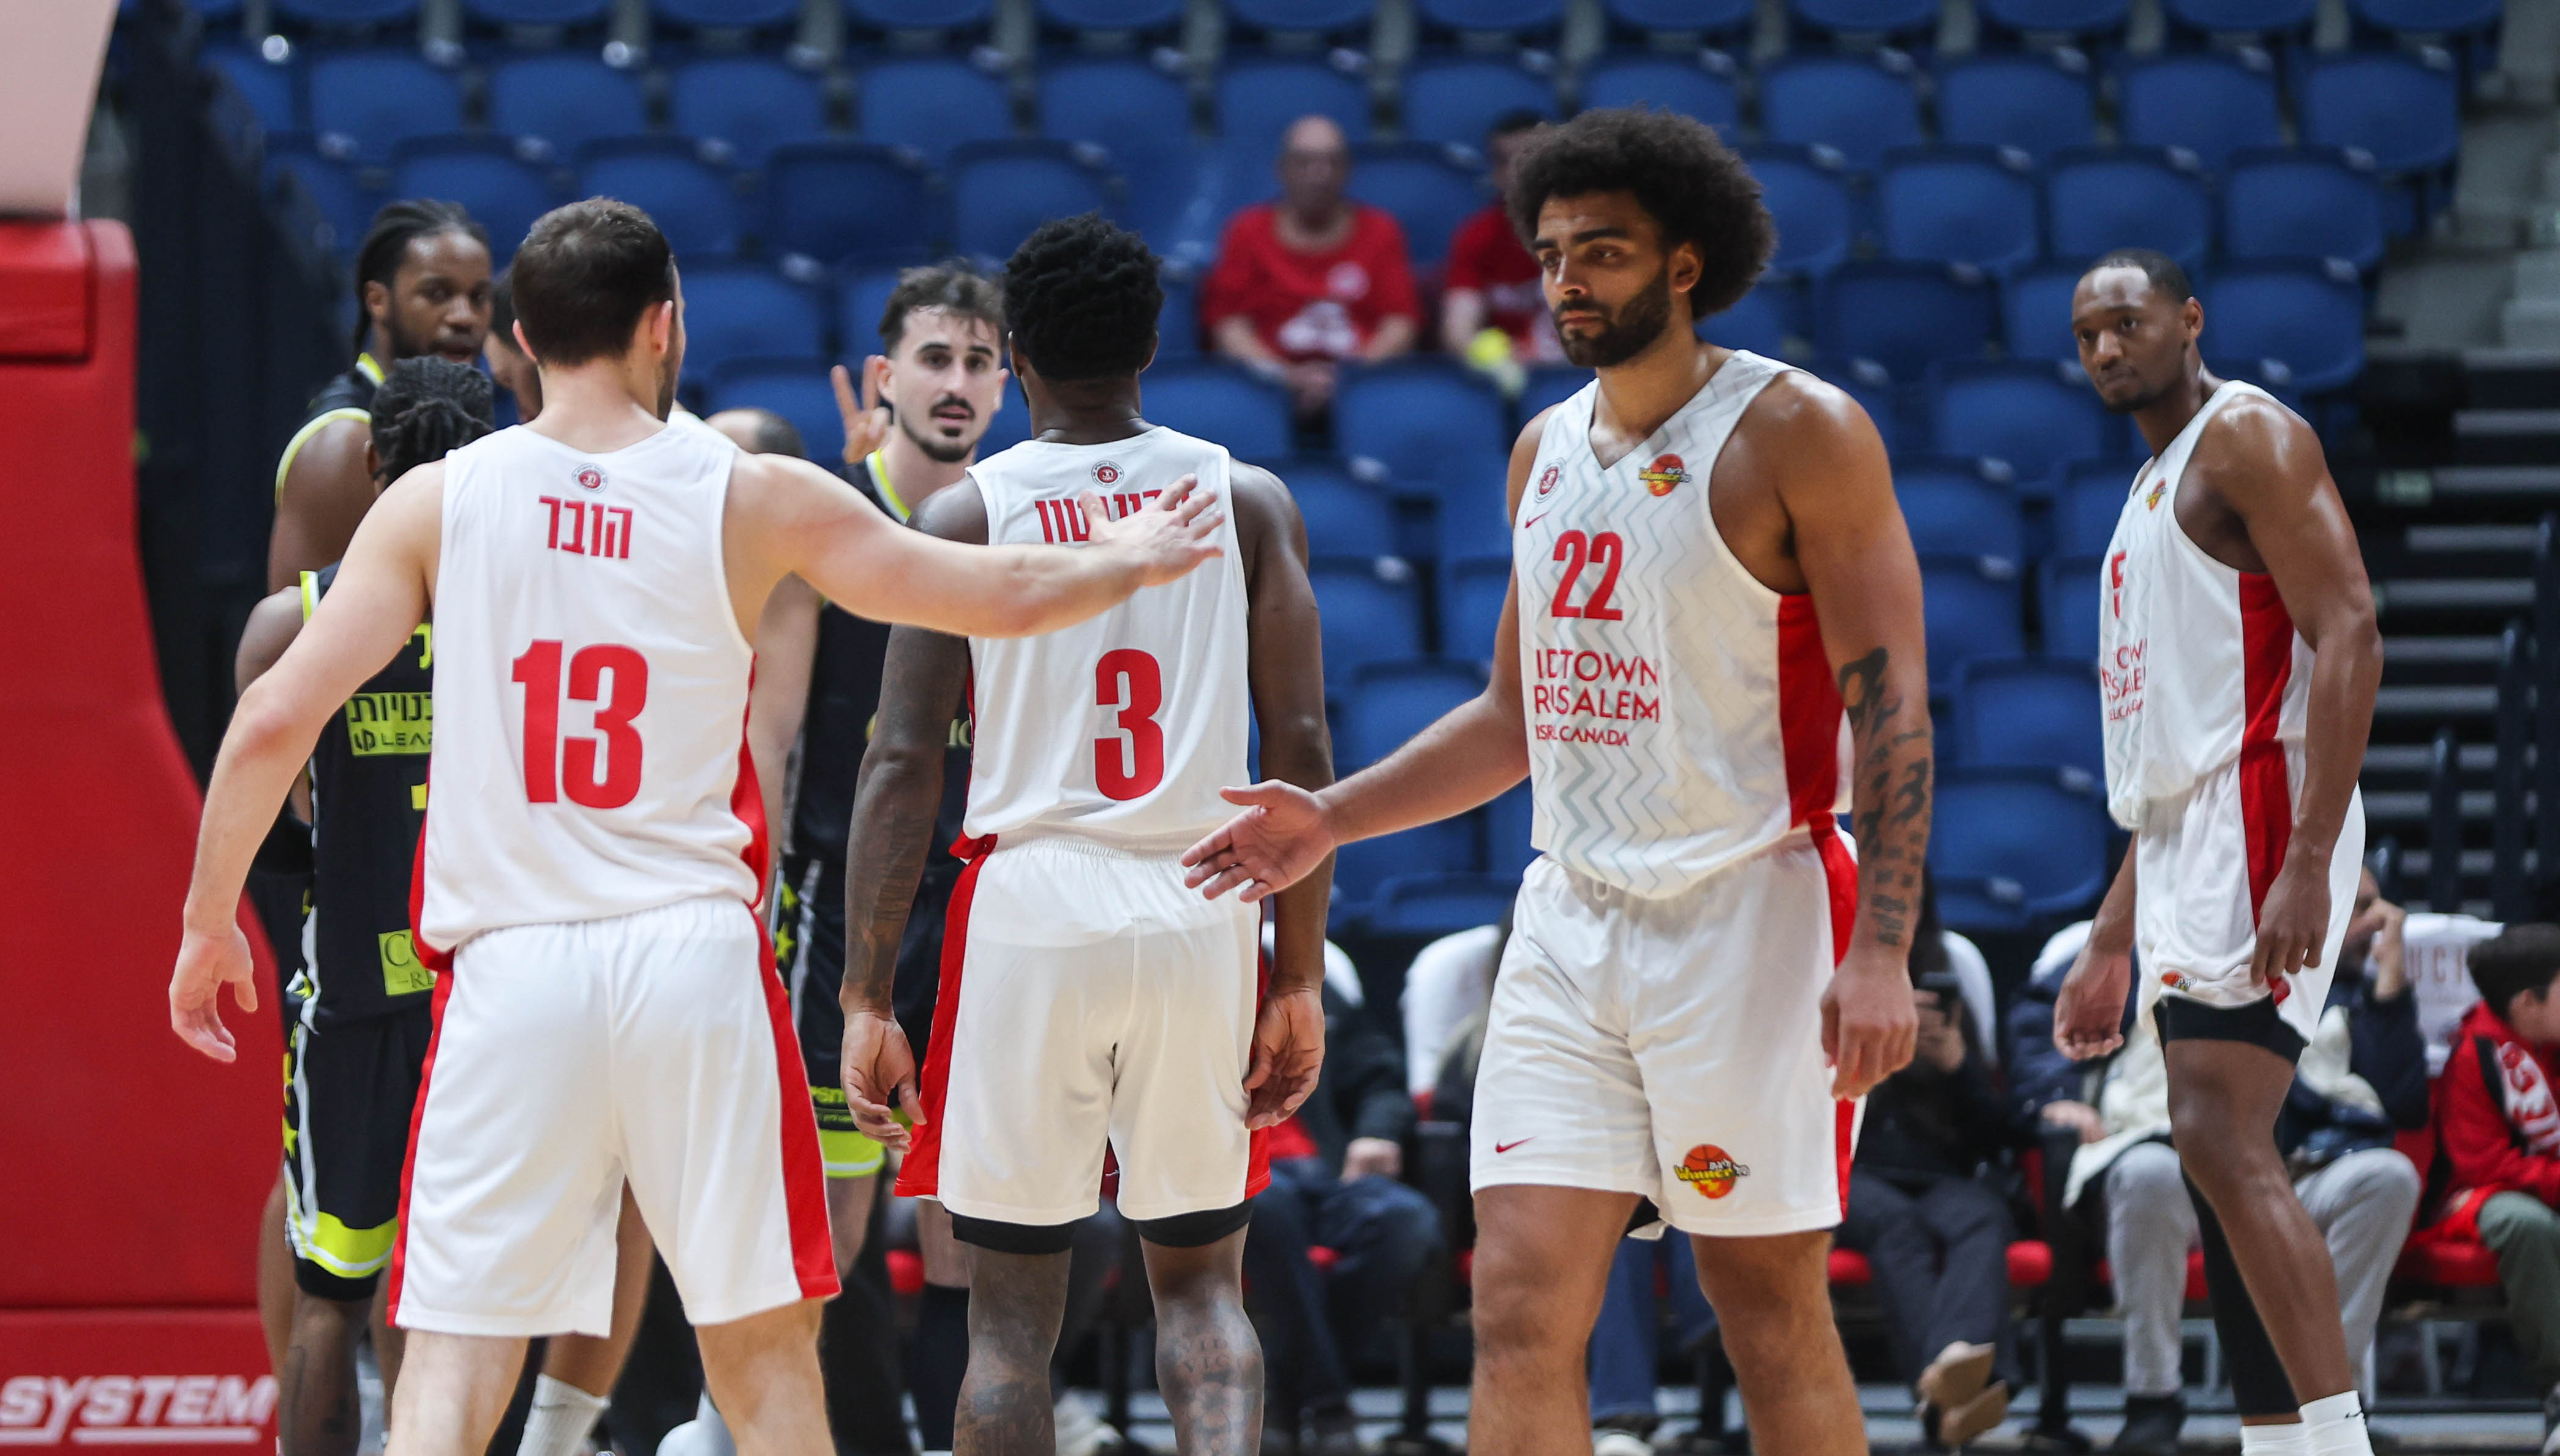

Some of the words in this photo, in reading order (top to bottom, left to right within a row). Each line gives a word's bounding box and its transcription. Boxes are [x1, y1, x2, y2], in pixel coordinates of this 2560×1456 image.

[539, 495, 633, 560] הובר
[1551, 529, 1623, 621] 22
[512, 639, 649, 809] 13
[1094, 648, 1164, 800] 3
[1, 1375, 279, 1441] SYSTEM
